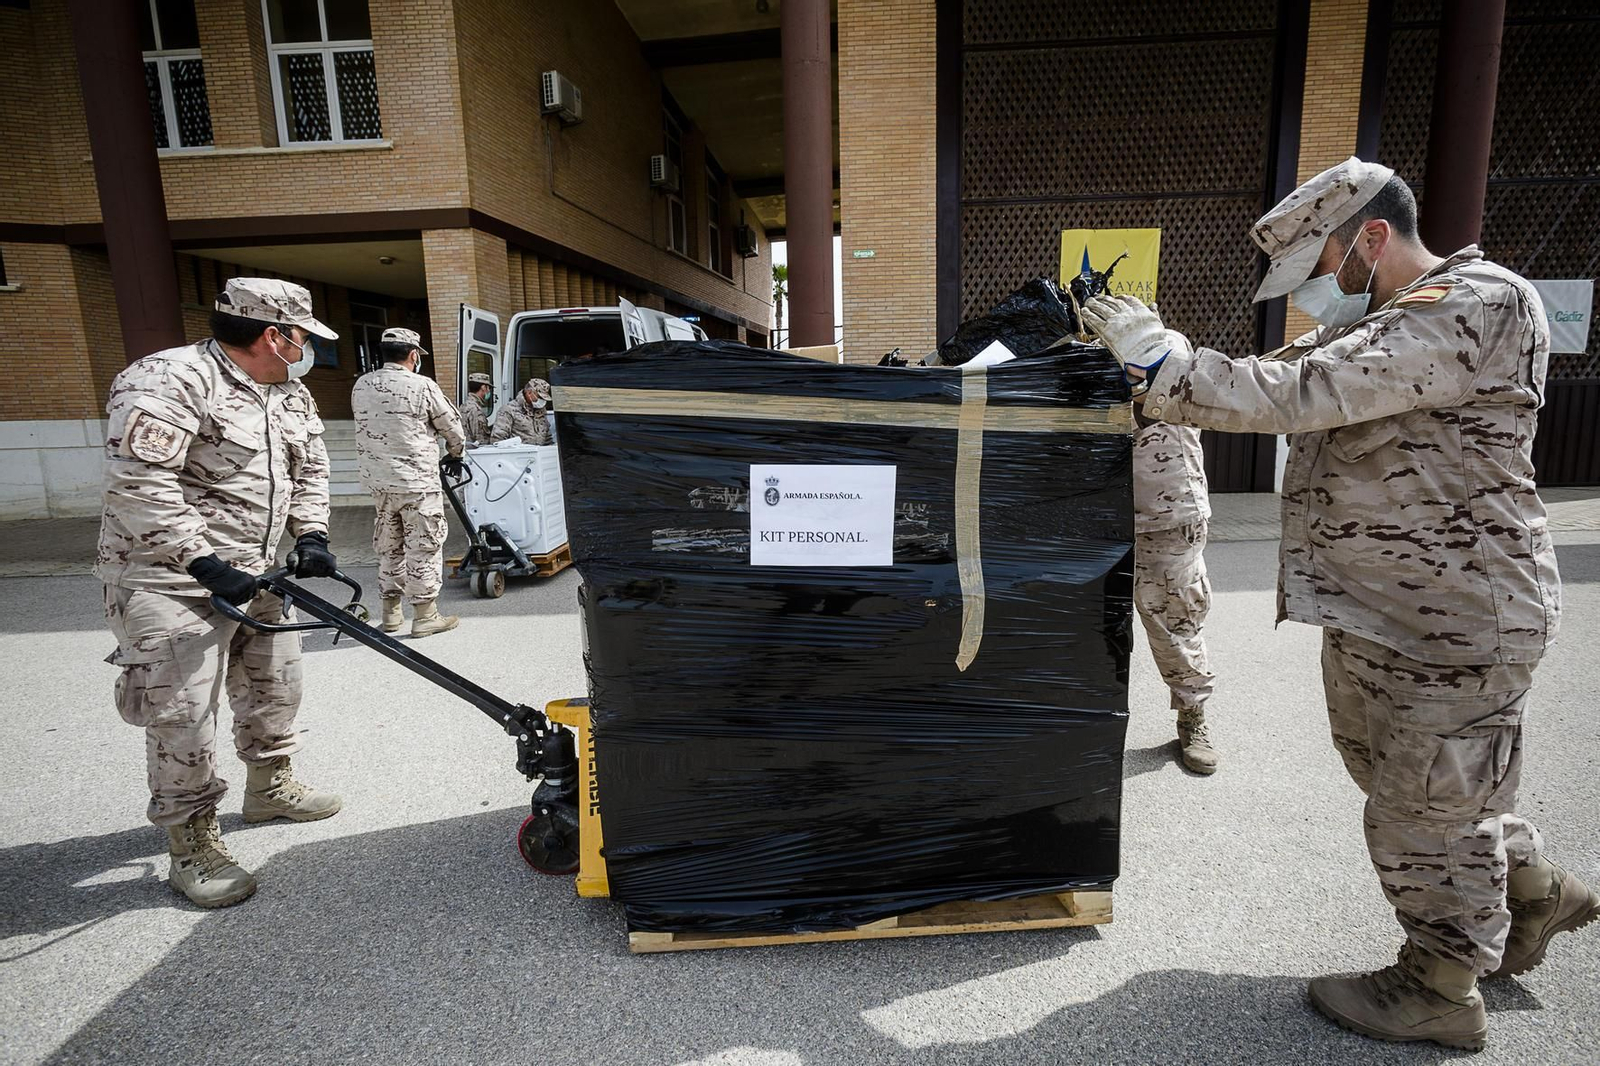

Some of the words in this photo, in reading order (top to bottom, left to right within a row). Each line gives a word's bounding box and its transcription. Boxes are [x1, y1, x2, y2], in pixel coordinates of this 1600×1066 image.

[1555, 310, 1584, 322] Cádiz
[783, 492, 819, 500] ARMADA
[819, 490, 863, 500] ESPAÑOLA.
[759, 530, 785, 543] KIT
[788, 530, 869, 543] PERSONAL.
